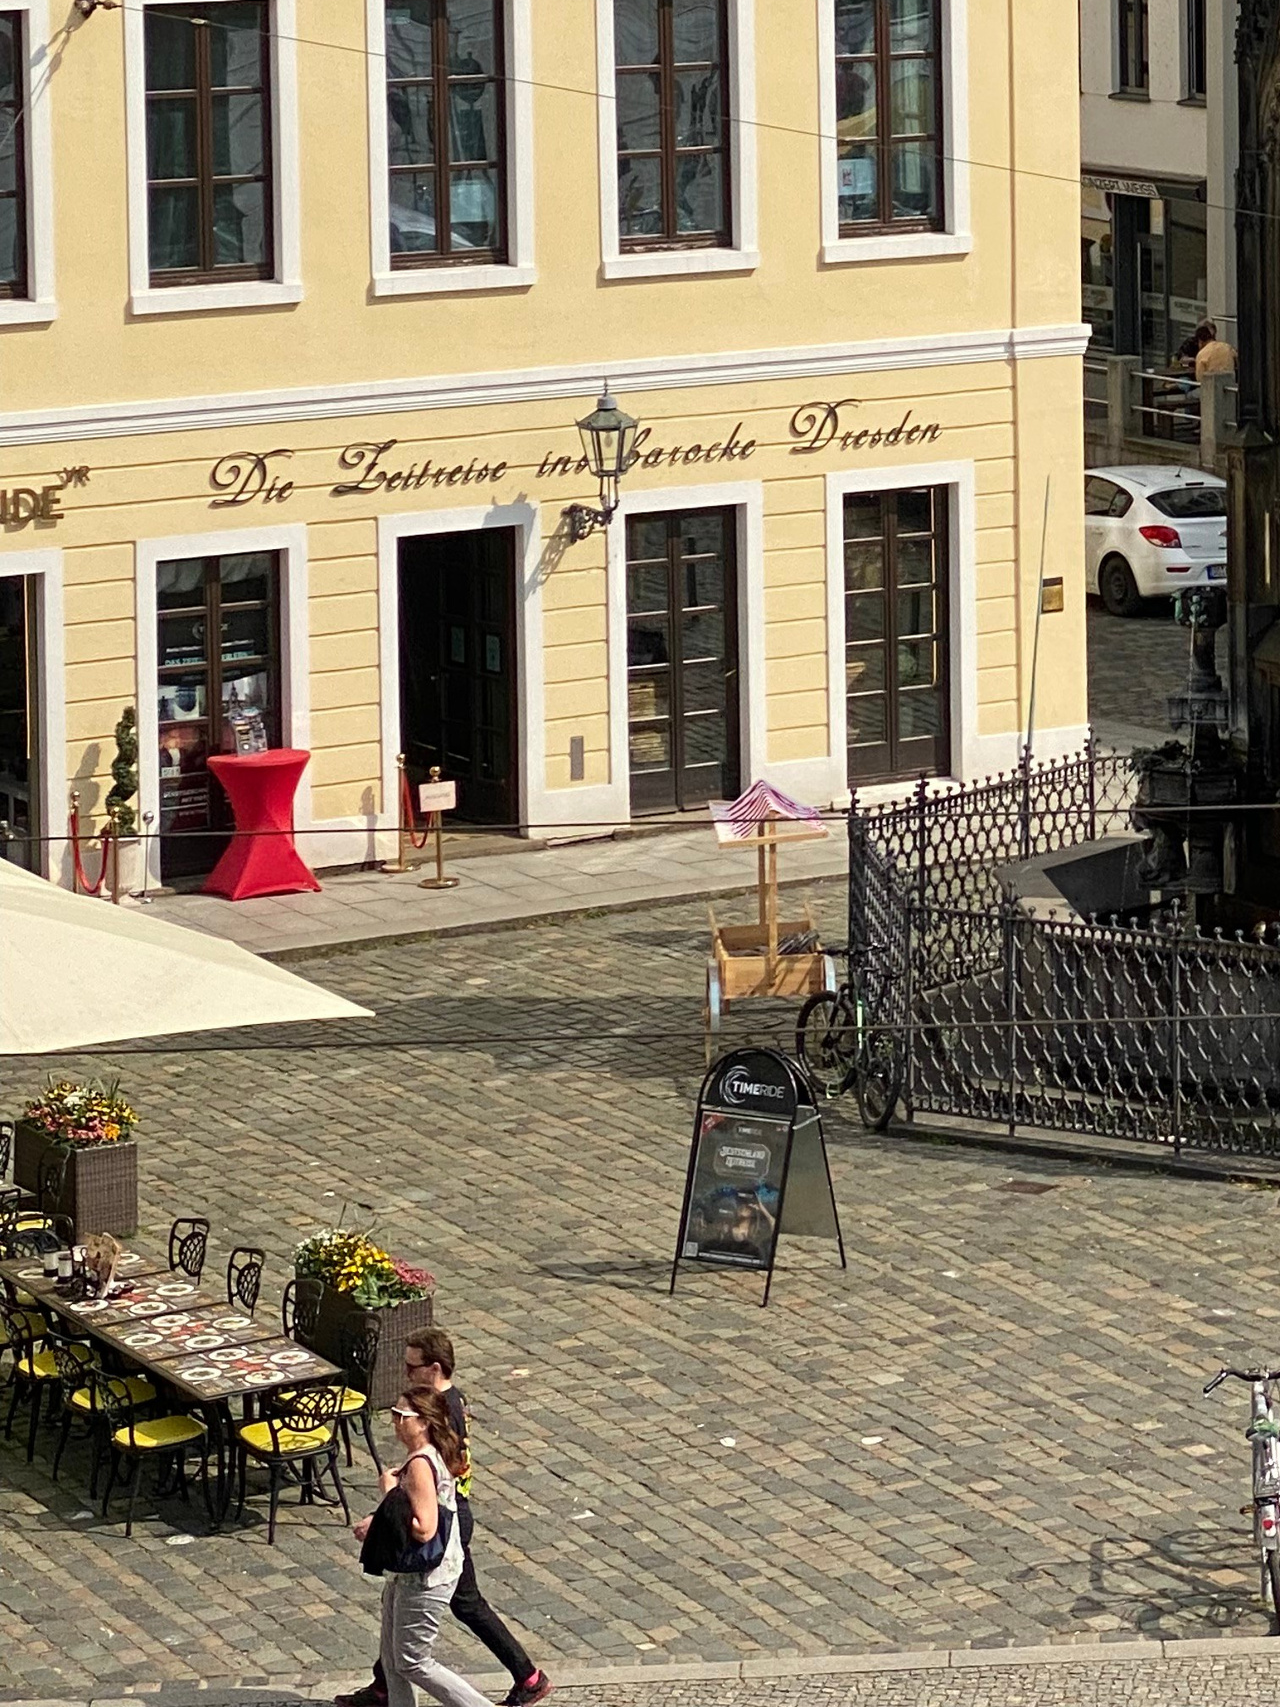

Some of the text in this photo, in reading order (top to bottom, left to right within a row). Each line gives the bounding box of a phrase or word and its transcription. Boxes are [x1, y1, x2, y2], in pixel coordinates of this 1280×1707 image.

[209, 449, 294, 508] Die
[329, 439, 507, 497] Zeitreise
[789, 398, 943, 456] Dresden
[0, 485, 64, 522] IDE
[732, 1080, 785, 1099] TIMERIDE
